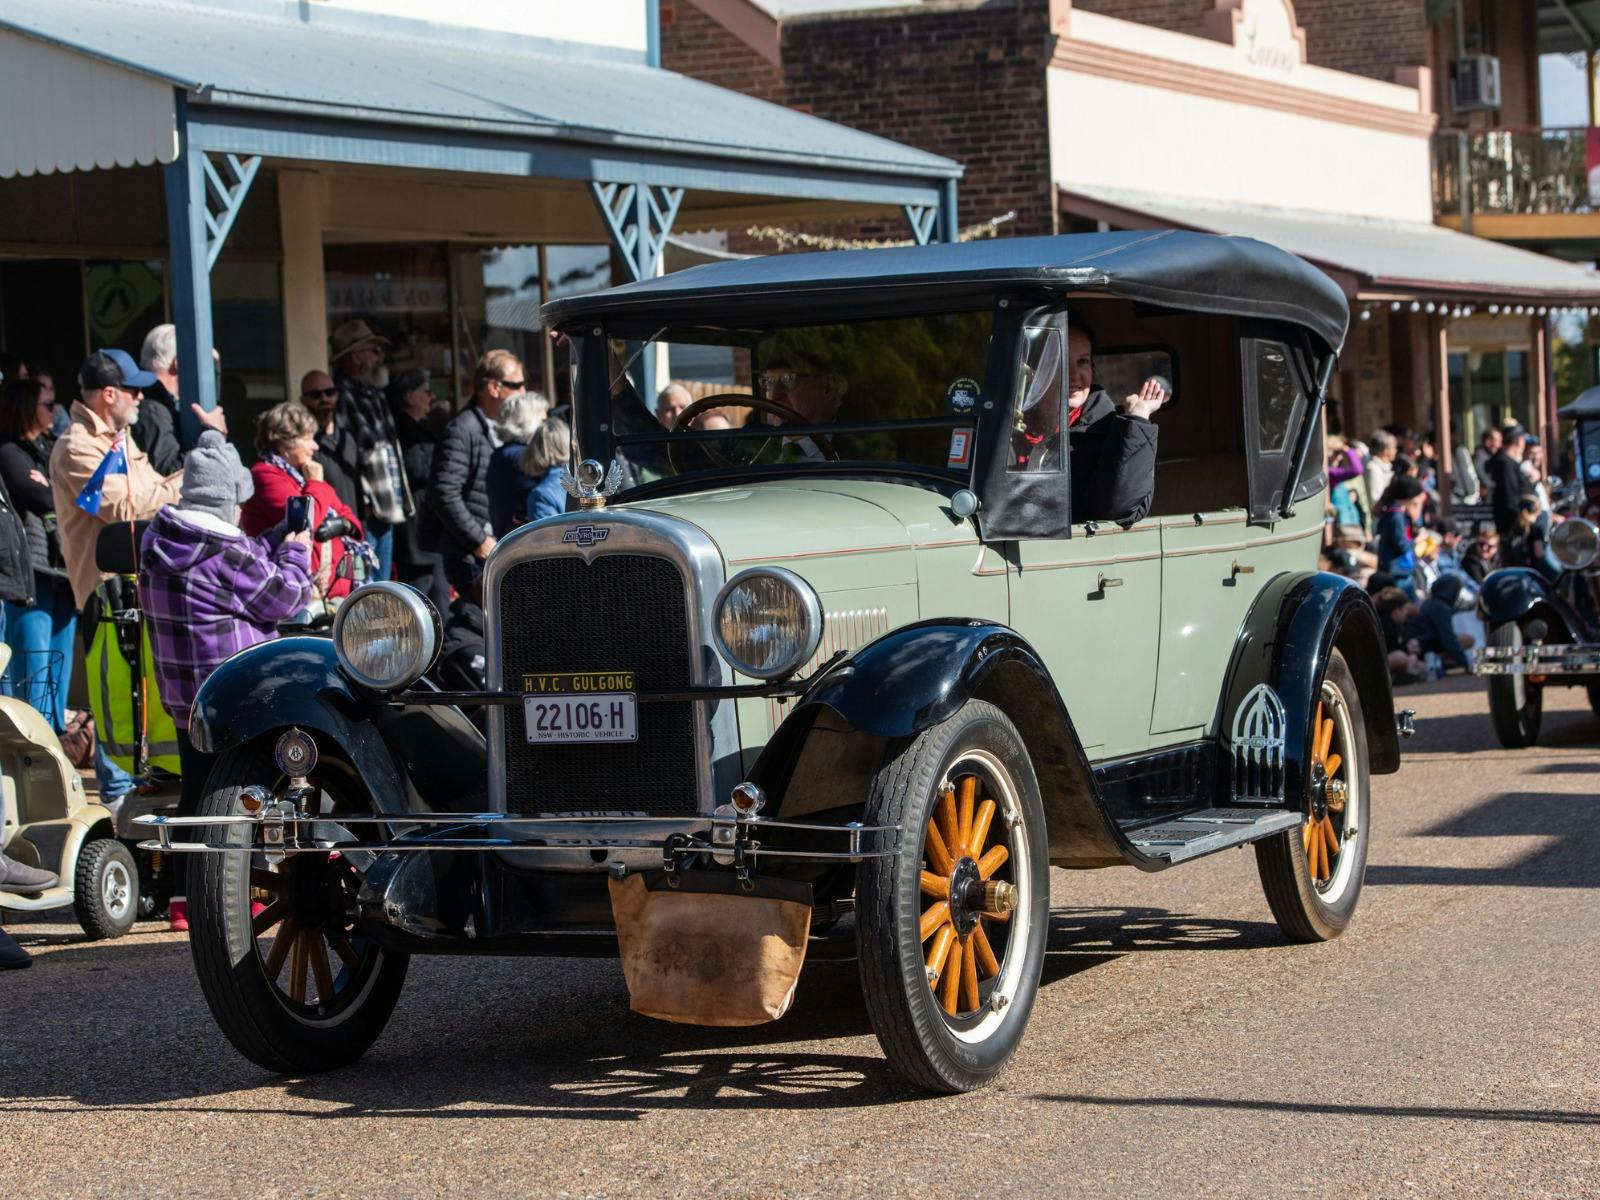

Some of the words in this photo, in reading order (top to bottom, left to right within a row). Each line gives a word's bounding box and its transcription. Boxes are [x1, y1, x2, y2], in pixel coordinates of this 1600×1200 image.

[525, 677, 566, 692] H.V.C.
[572, 675, 633, 690] GULGONG
[557, 731, 590, 739] HISTORIC
[594, 730, 625, 738] VEHICLE
